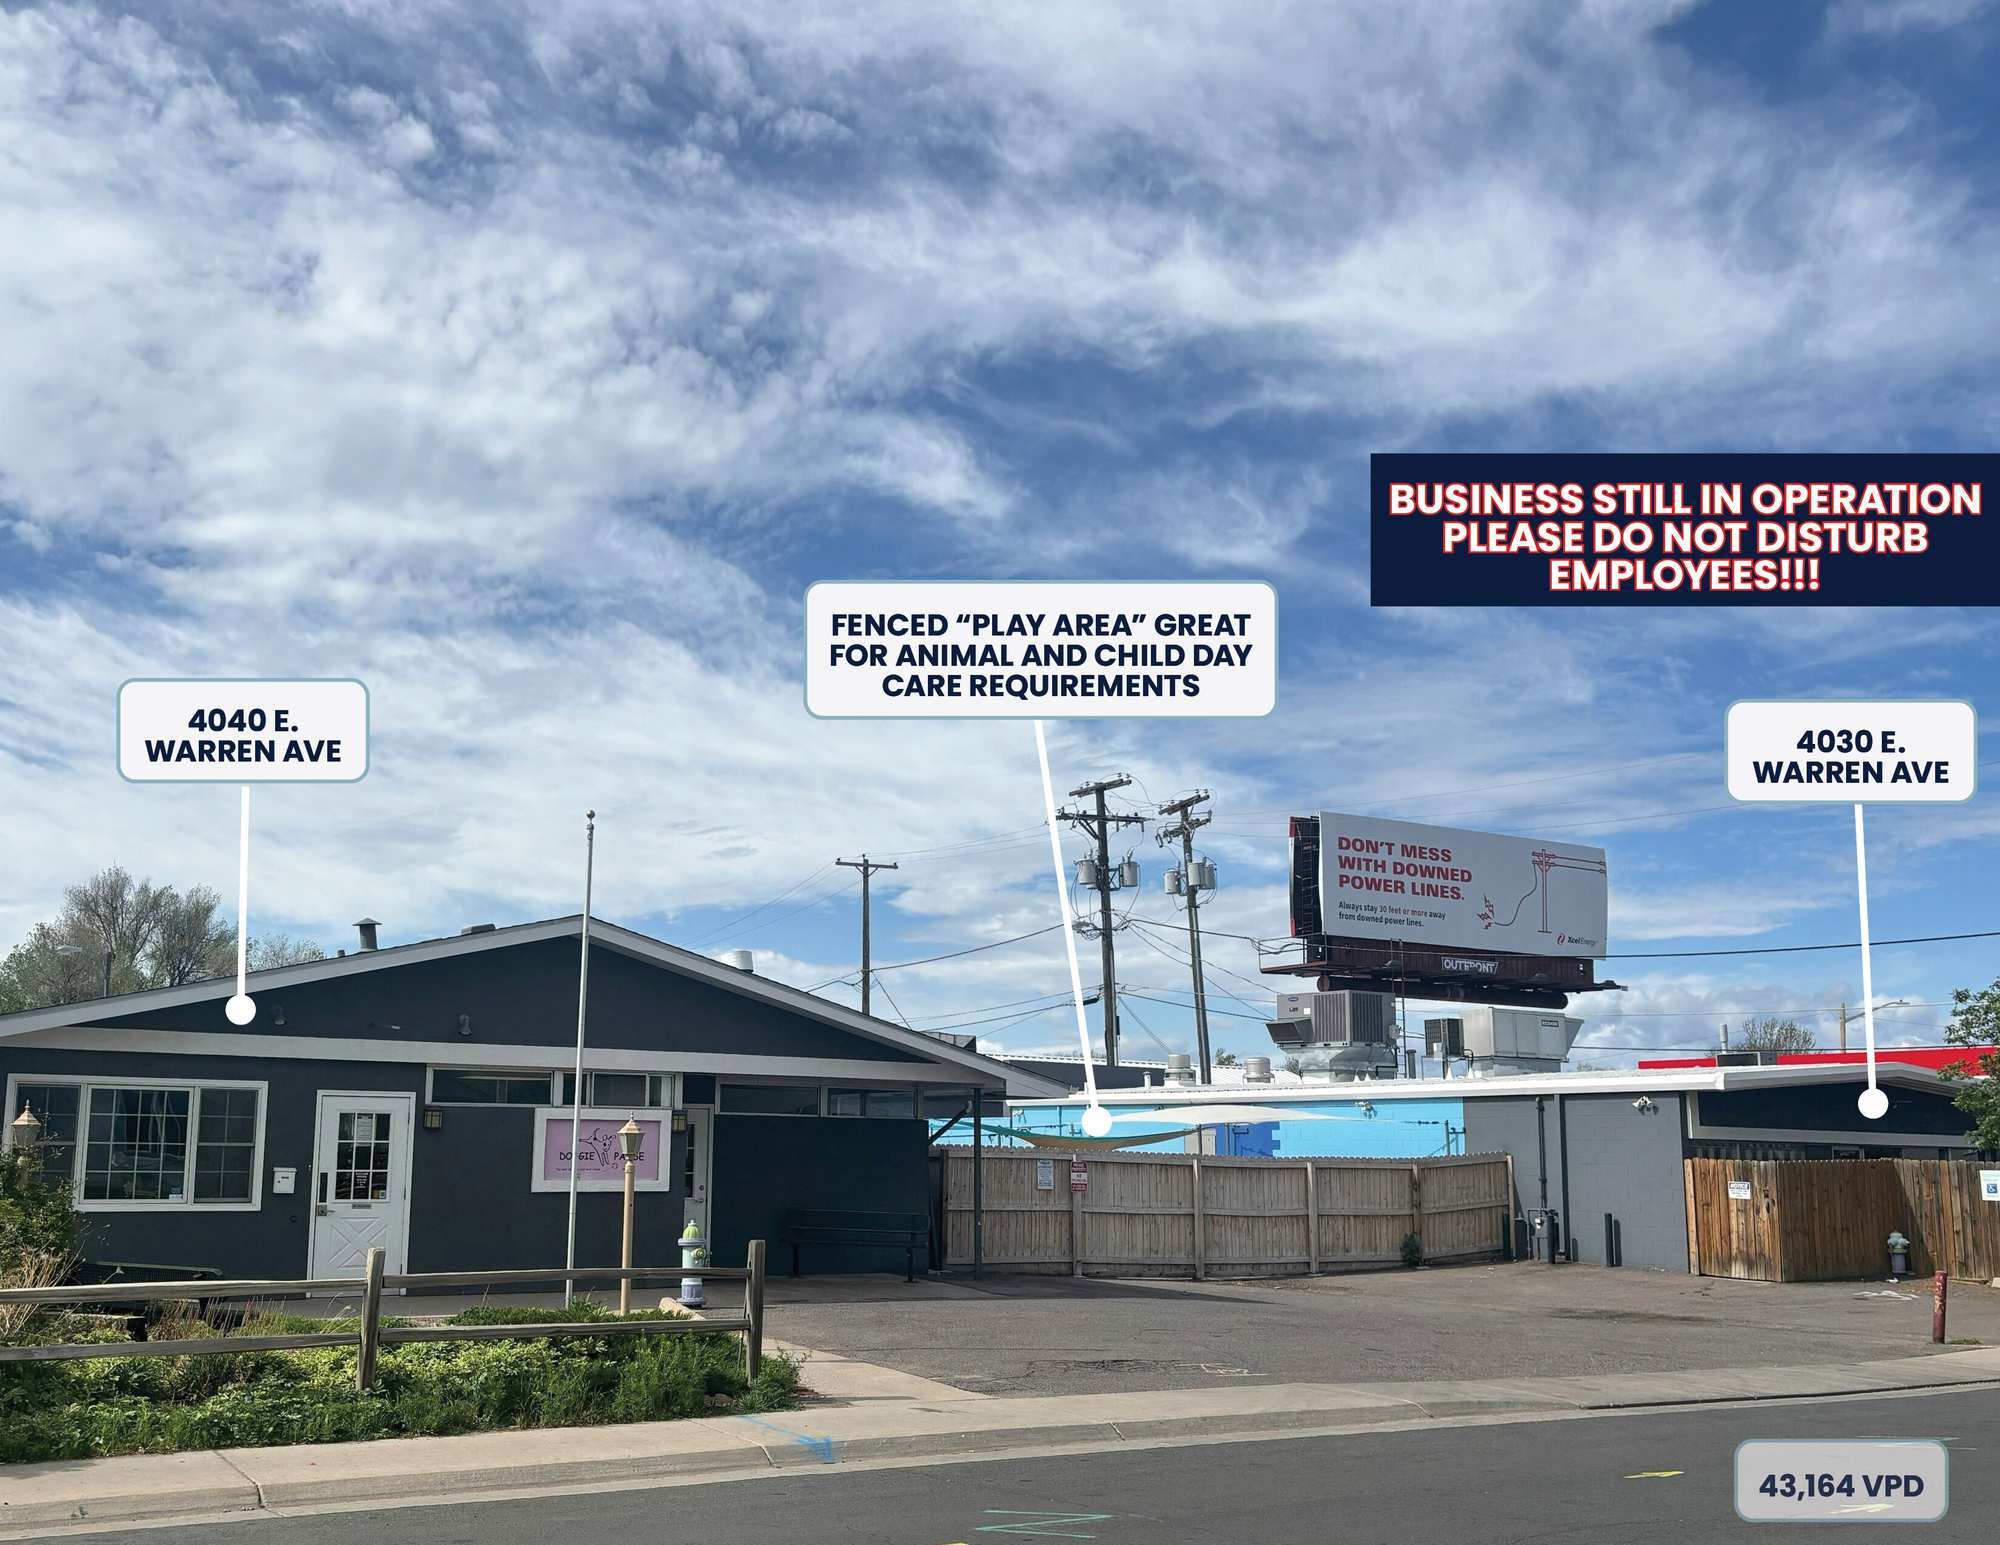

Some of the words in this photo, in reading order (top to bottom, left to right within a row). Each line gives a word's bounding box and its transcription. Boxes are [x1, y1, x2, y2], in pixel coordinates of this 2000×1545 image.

[1401, 844, 1452, 862] MESS
[1338, 856, 1386, 873] WITH
[1393, 862, 1472, 882] DOWNED
[1339, 875, 1405, 894] POWER
[1411, 882, 1465, 900] LINES.
[1338, 901, 1363, 912] Always
[1364, 904, 1378, 914] stay
[1388, 906, 1402, 915] feet
[1411, 909, 1428, 917] more
[1428, 911, 1446, 920] away
[1339, 912, 1356, 921] from
[1356, 913, 1384, 924] downed
[1384, 916, 1405, 926] power
[1406, 917, 1424, 927] lines.
[559, 1152, 595, 1161] DOGIE
[613, 1152, 645, 1161] PASE
